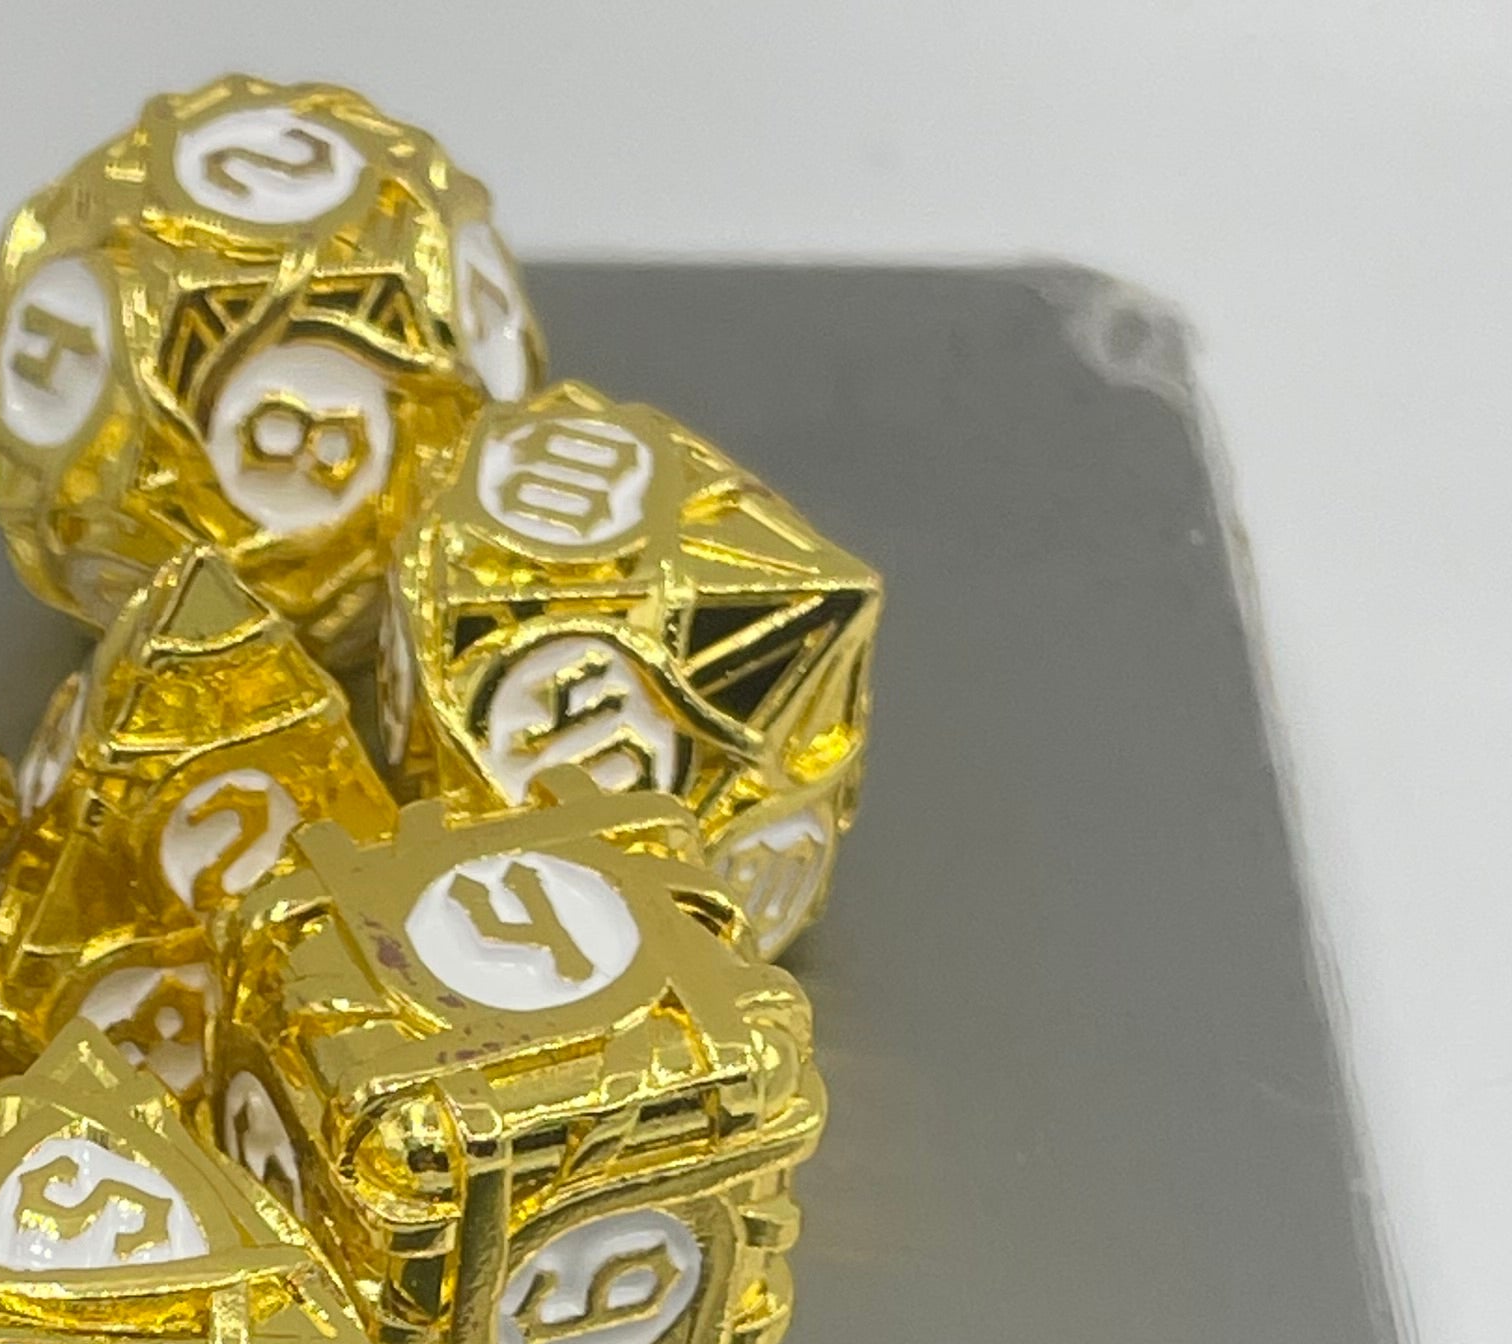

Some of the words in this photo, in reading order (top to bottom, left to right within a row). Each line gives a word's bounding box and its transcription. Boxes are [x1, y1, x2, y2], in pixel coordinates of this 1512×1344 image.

[201, 127, 338, 202] 2
[10, 304, 102, 394] 4
[236, 392, 371, 496] 8
[500, 420, 640, 538] 00
[447, 860, 594, 984] 4
[15, 1153, 175, 1262] 5
